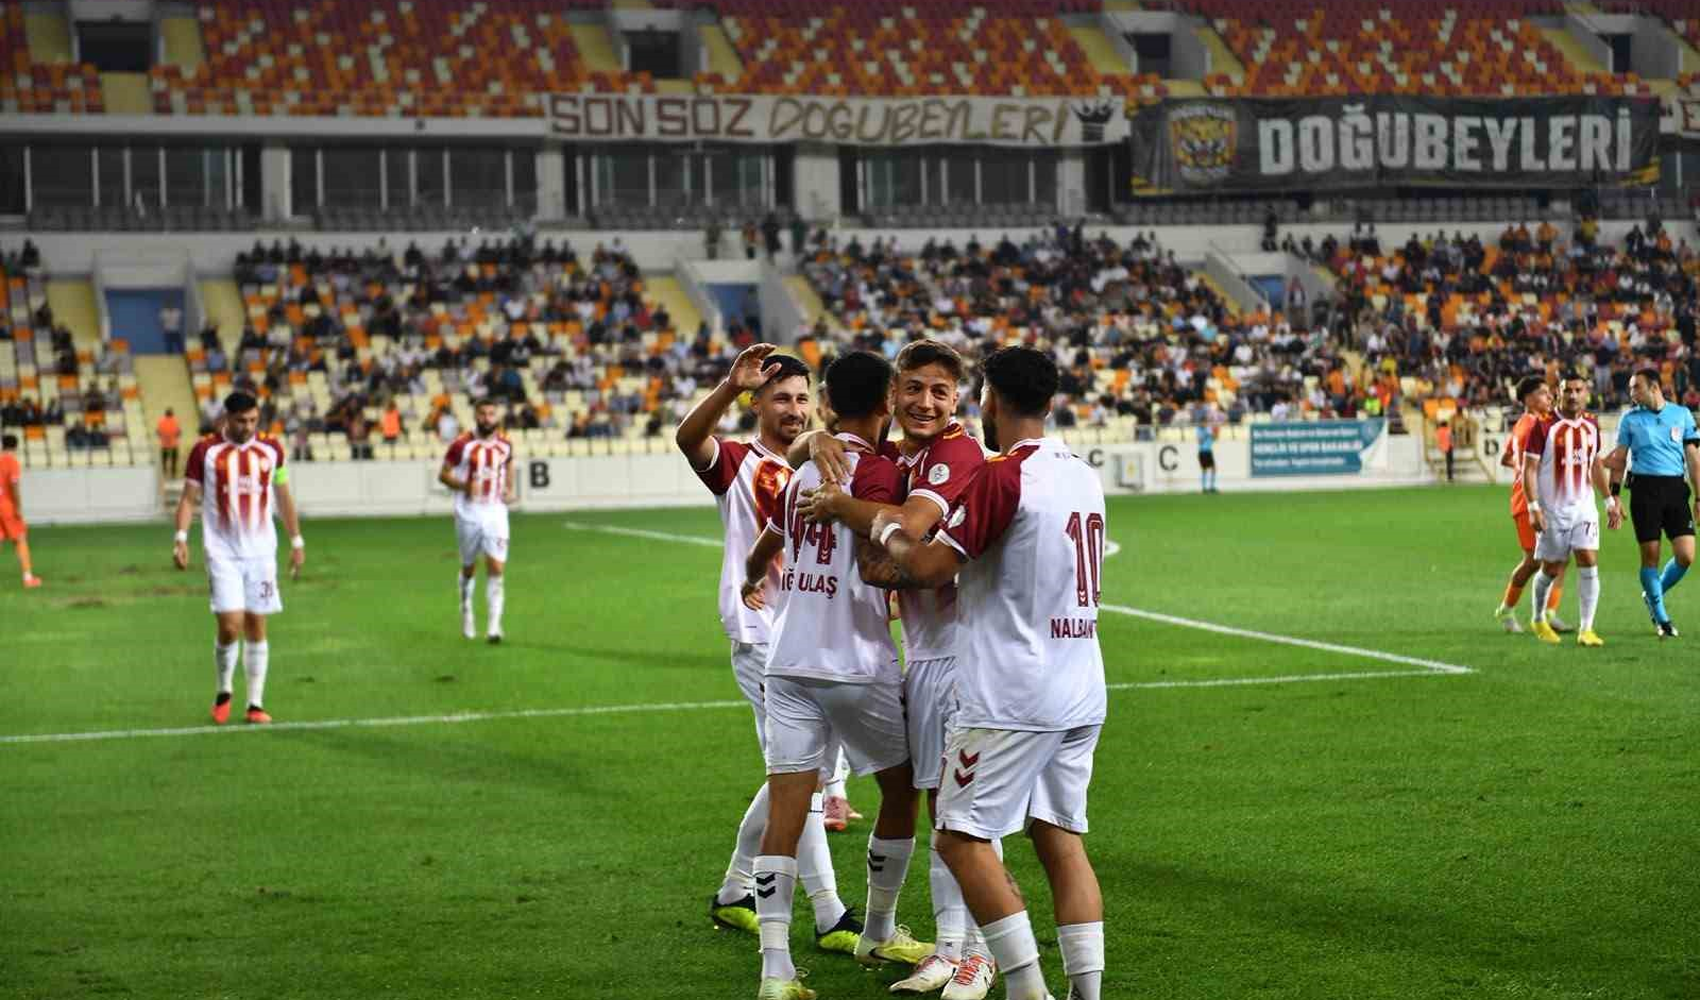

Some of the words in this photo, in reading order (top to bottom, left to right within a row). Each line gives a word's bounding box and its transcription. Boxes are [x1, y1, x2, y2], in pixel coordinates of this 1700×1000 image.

[550, 96, 645, 136] SON
[1258, 104, 1632, 175] DOĞUBEYLERİ
[1088, 448, 1104, 468] C
[1159, 445, 1178, 471] C
[529, 461, 550, 488] B
[1065, 511, 1104, 608] 10
[798, 572, 838, 599] ULAŞ
